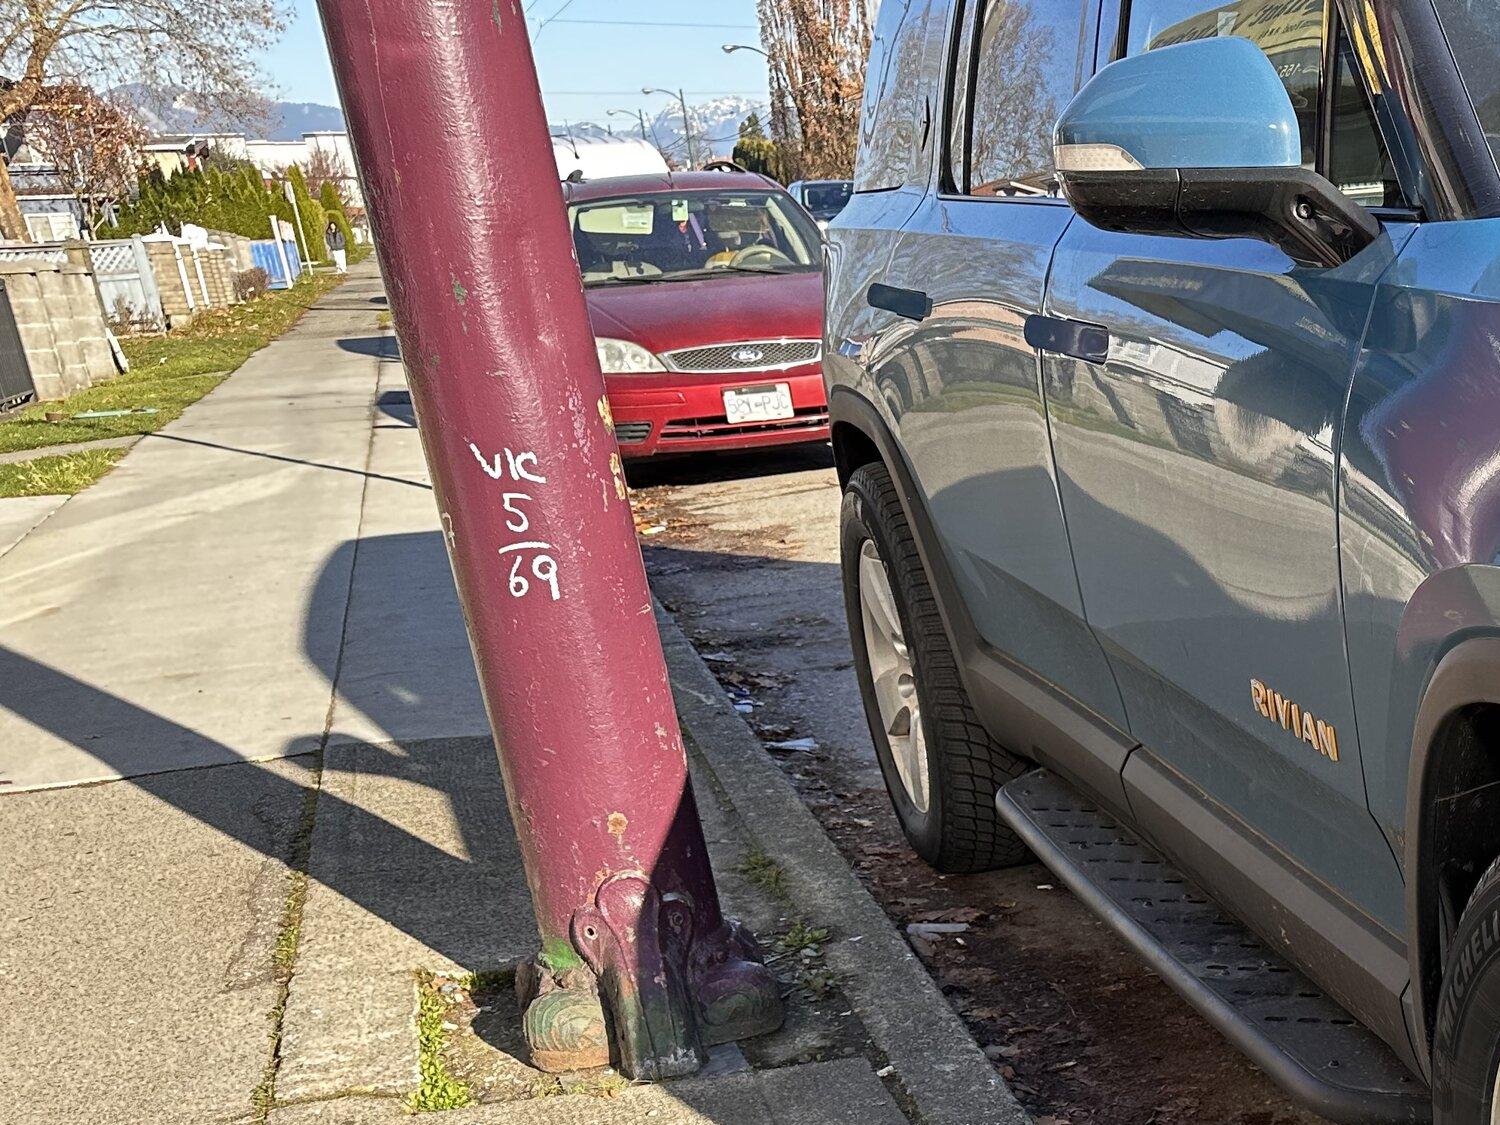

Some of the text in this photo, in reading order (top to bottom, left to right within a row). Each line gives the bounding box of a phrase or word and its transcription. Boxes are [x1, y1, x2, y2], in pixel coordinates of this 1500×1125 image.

[464, 440, 547, 484] VIC
[503, 492, 532, 533] 5
[509, 554, 561, 601] 69
[1250, 678, 1339, 762] RIVIAN
